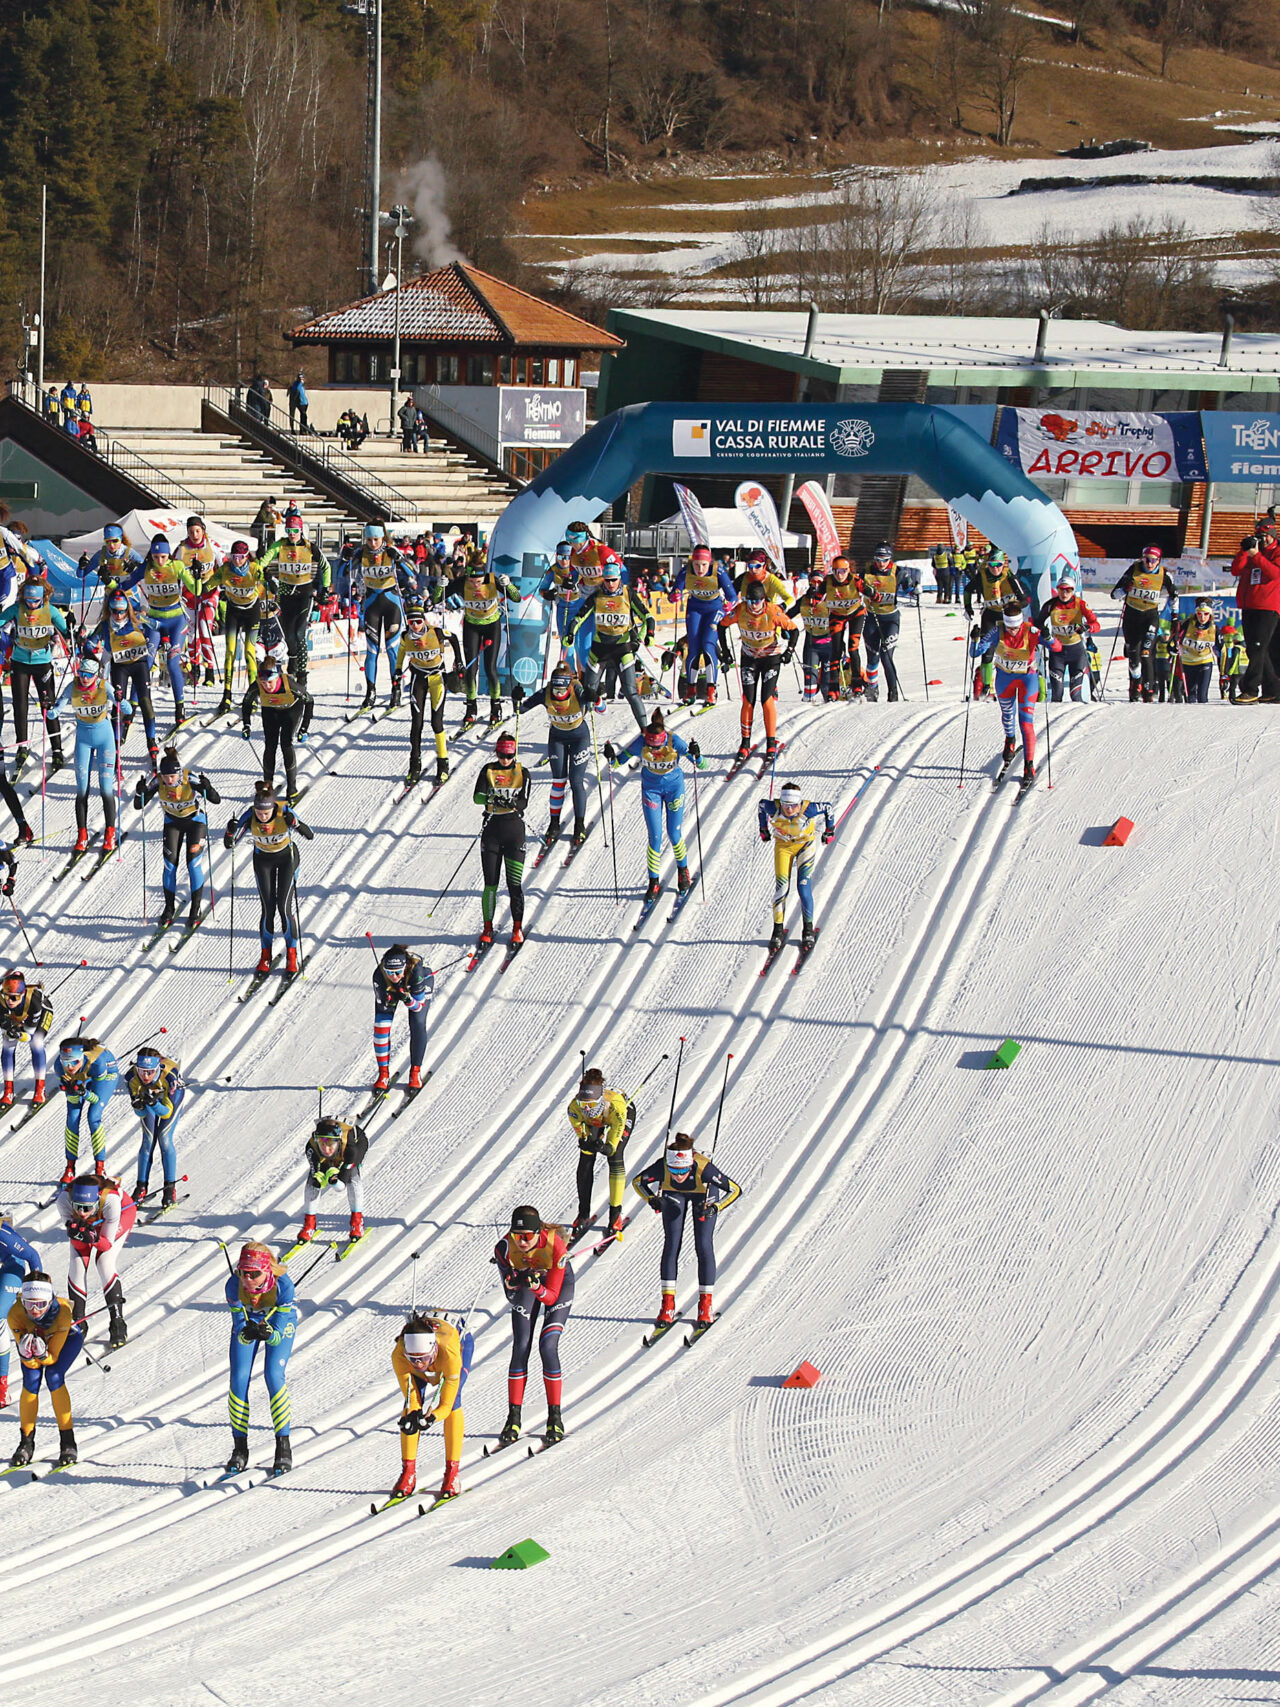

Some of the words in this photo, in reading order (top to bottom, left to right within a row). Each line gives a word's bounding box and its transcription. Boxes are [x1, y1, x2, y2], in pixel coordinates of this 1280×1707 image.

[524, 398, 561, 421] TRENTINO
[716, 419, 743, 432] VAL
[748, 419, 763, 432] DI
[768, 419, 826, 432] FIEMME
[1118, 421, 1154, 440] Trophy
[524, 428, 561, 440] fiemme
[1231, 424, 1280, 450] TREN
[715, 435, 764, 449] CASSA
[769, 435, 825, 449] RURALE
[1027, 448, 1172, 478] ARRIVO
[283, 563, 307, 573] 1134
[151, 584, 175, 595] 1185
[118, 647, 144, 659] 1094
